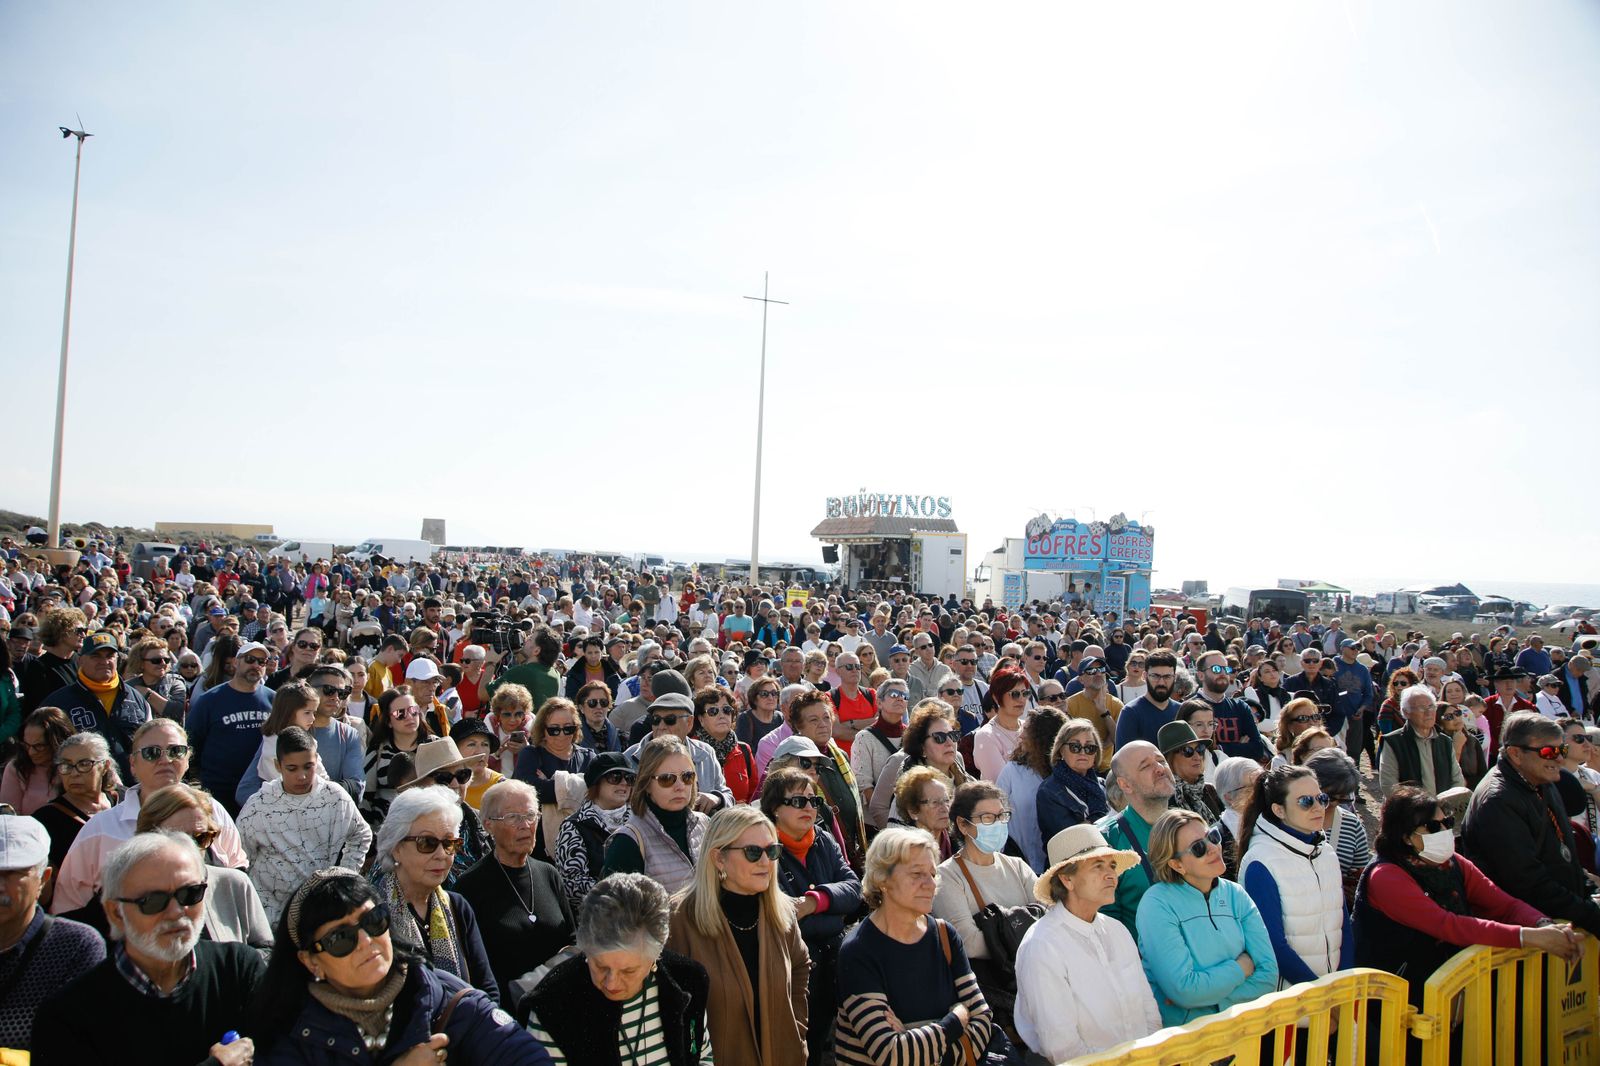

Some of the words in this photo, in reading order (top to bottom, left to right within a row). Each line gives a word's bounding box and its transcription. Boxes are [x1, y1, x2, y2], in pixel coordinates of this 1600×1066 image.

[1028, 534, 1102, 555] GOFRES
[1110, 534, 1152, 548] GOFRES
[1110, 547, 1151, 560] CREPES
[222, 710, 271, 725] CONVERS
[1561, 989, 1587, 1011] villar
